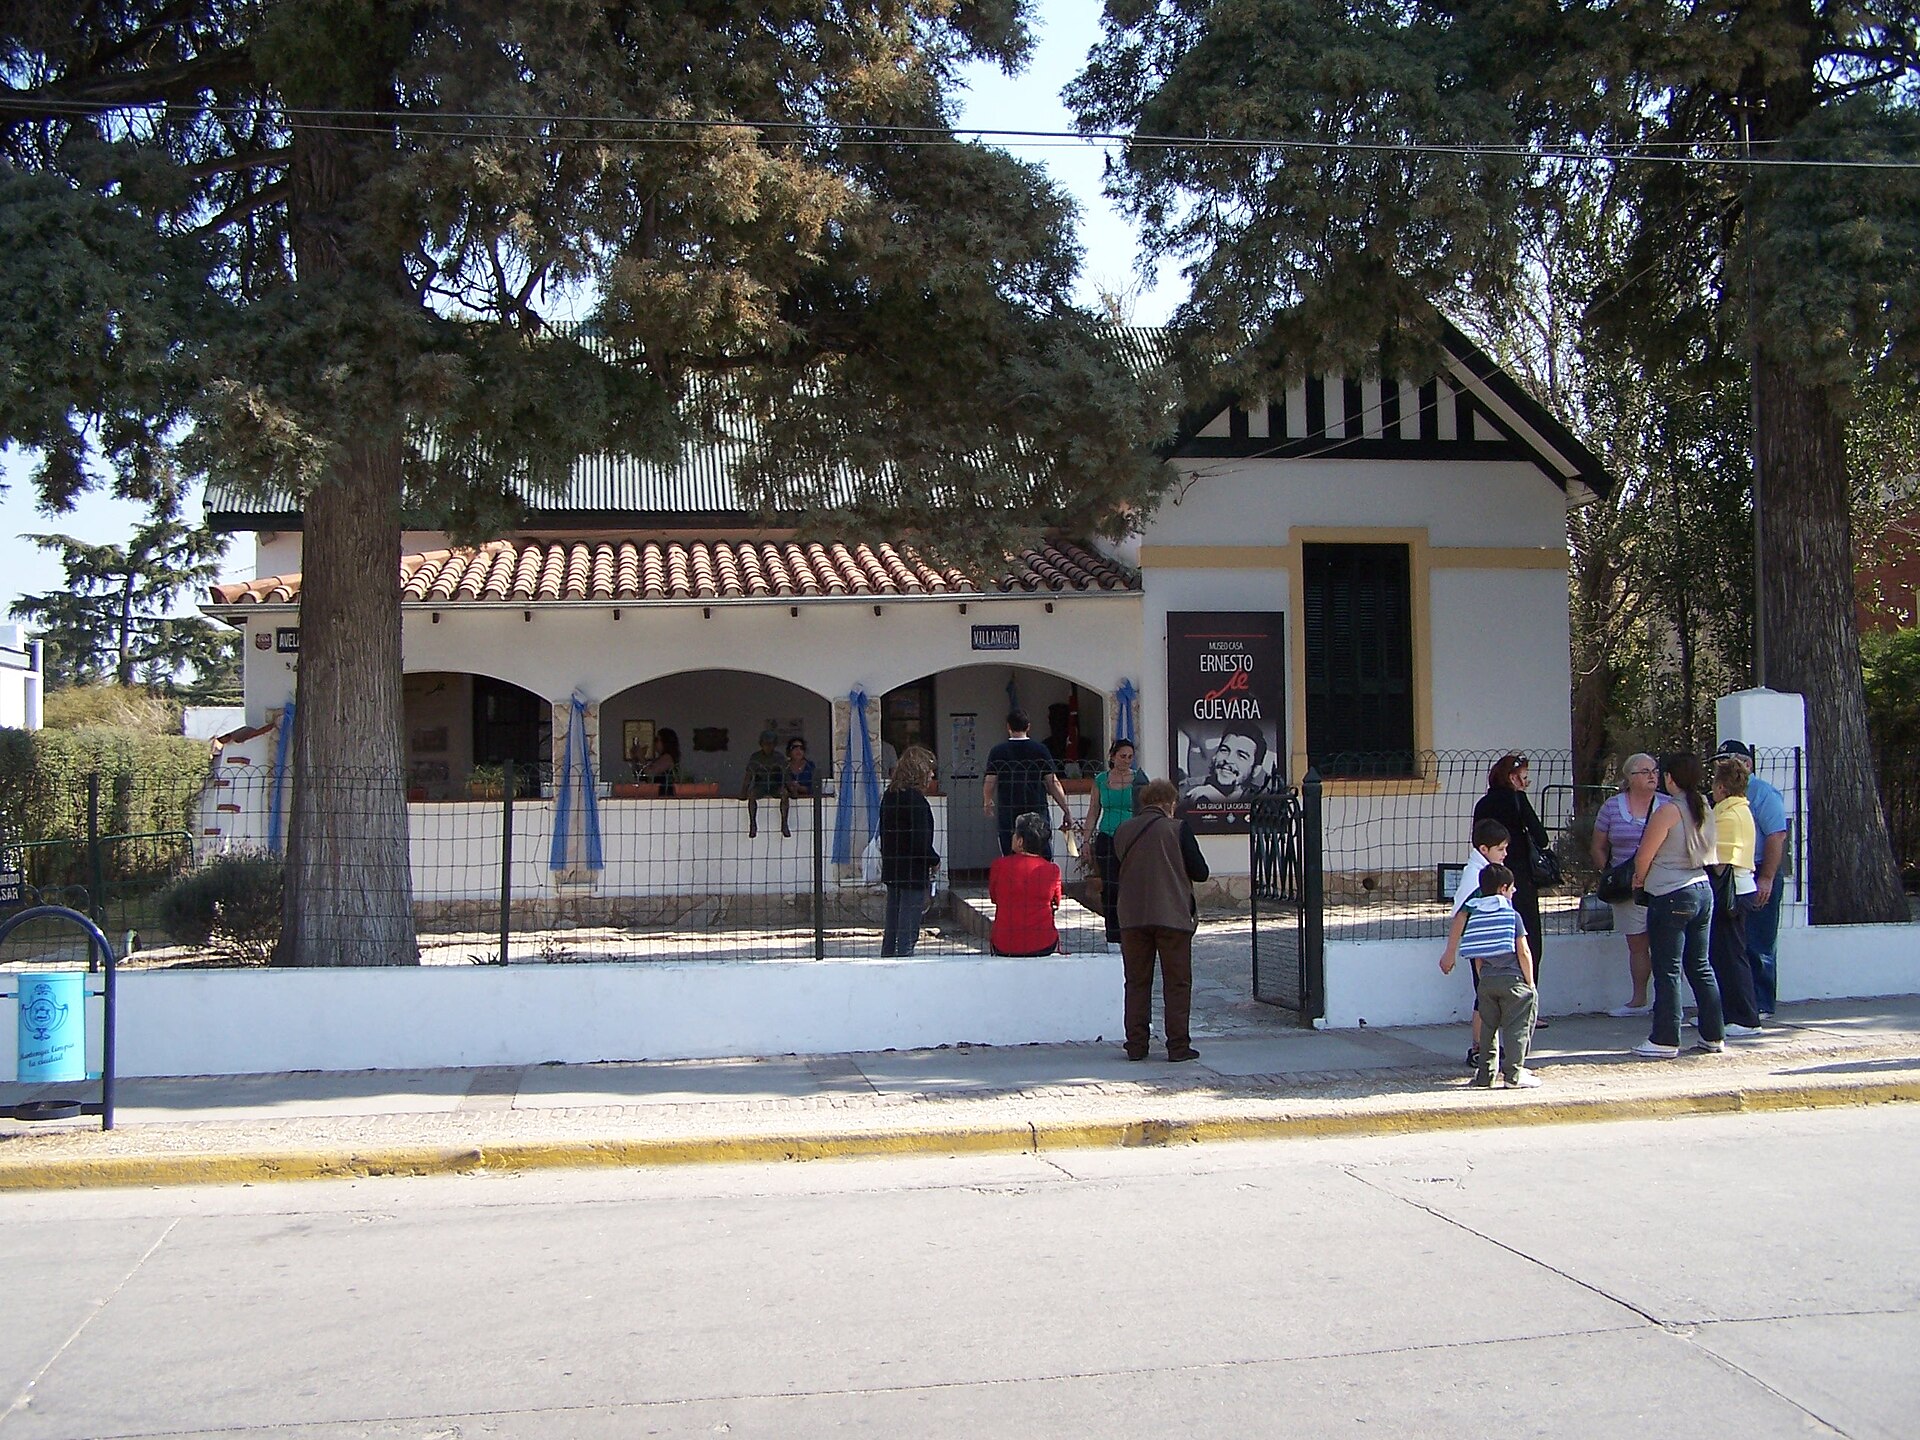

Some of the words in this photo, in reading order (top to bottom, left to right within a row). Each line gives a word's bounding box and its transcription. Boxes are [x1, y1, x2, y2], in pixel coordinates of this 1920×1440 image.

[1208, 641, 1228, 651] MUSEO
[1229, 641, 1244, 651] CASA
[1200, 654, 1253, 672] ERNESTO
[1193, 699, 1262, 719] GUEVARA
[0, 887, 19, 901] SAR
